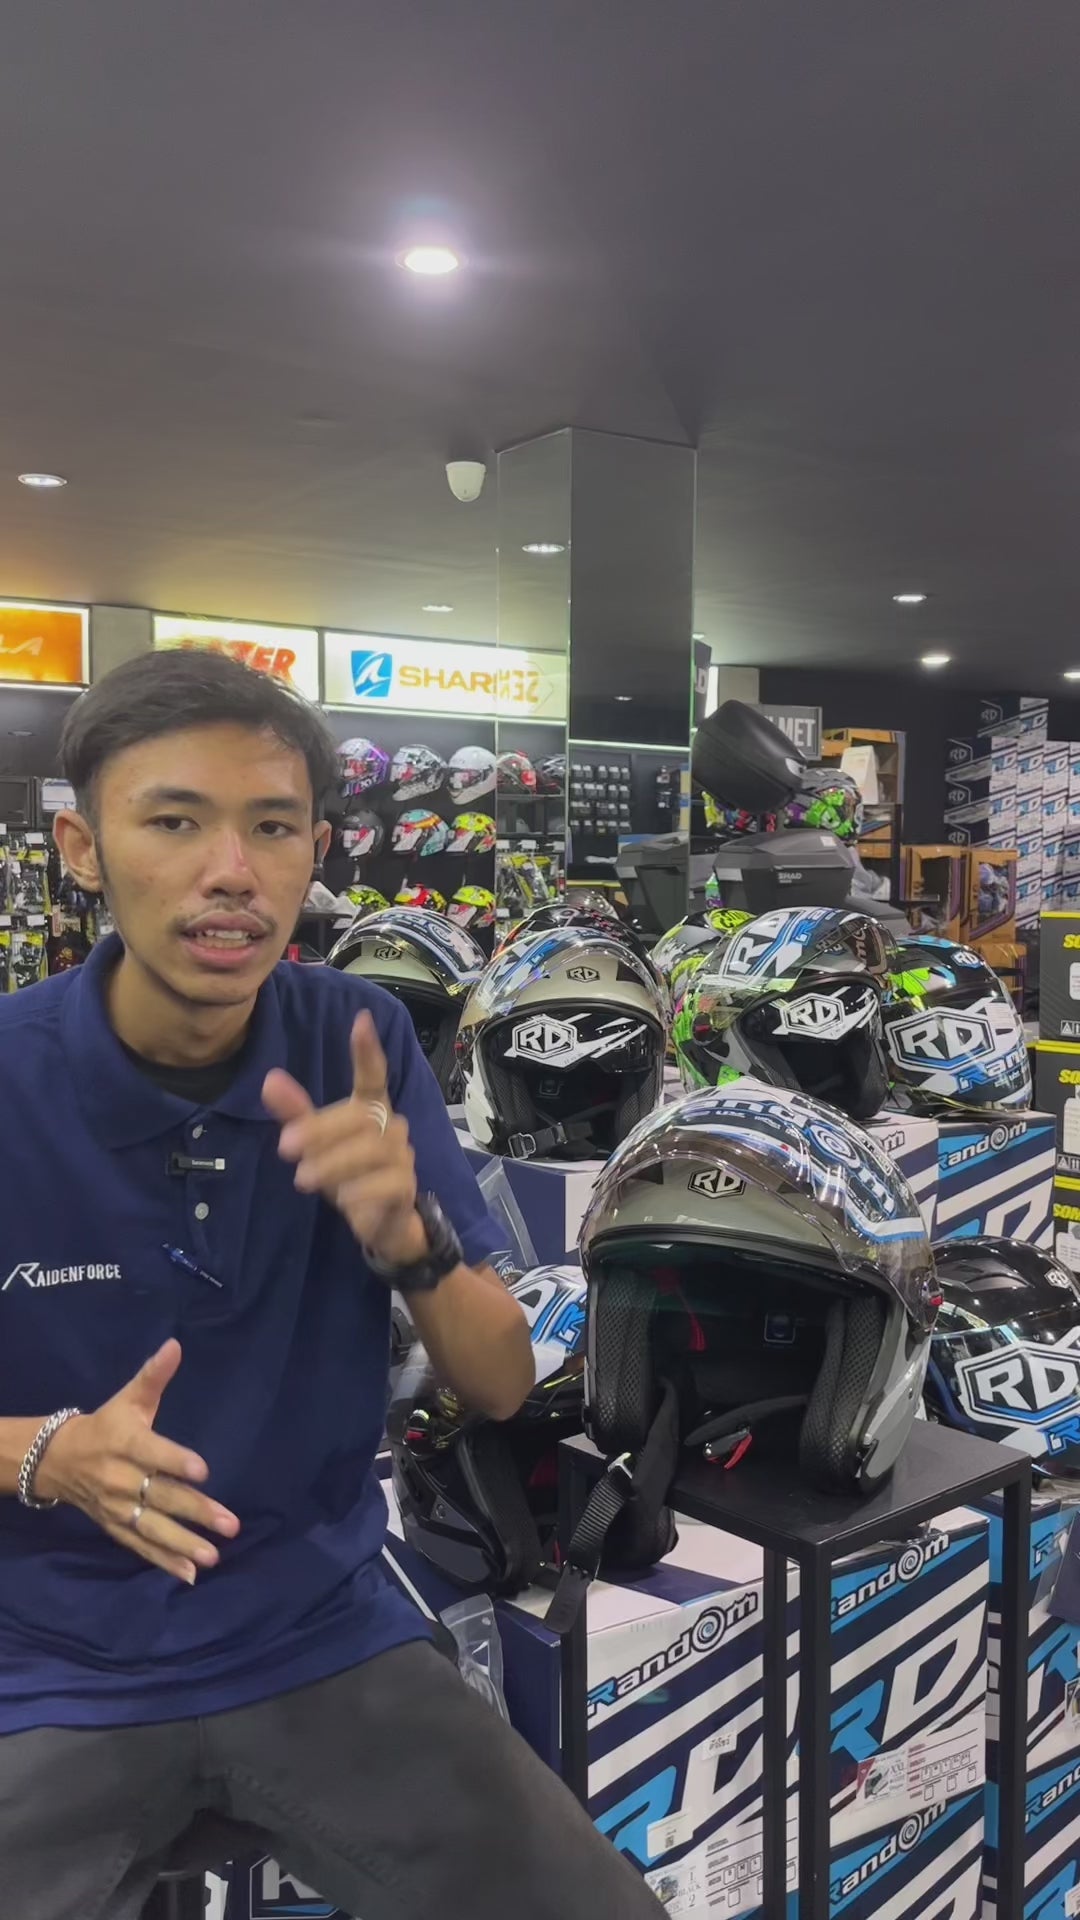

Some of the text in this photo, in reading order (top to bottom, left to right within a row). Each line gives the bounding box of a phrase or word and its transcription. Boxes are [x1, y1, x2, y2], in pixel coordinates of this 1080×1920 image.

[764, 715, 817, 748] MET
[570, 967, 599, 981] RD
[789, 1001, 838, 1028] RD
[518, 1024, 571, 1051] RD
[900, 1017, 986, 1062] RD
[690, 1169, 744, 1192] RD
[975, 1355, 1080, 1414] RD
